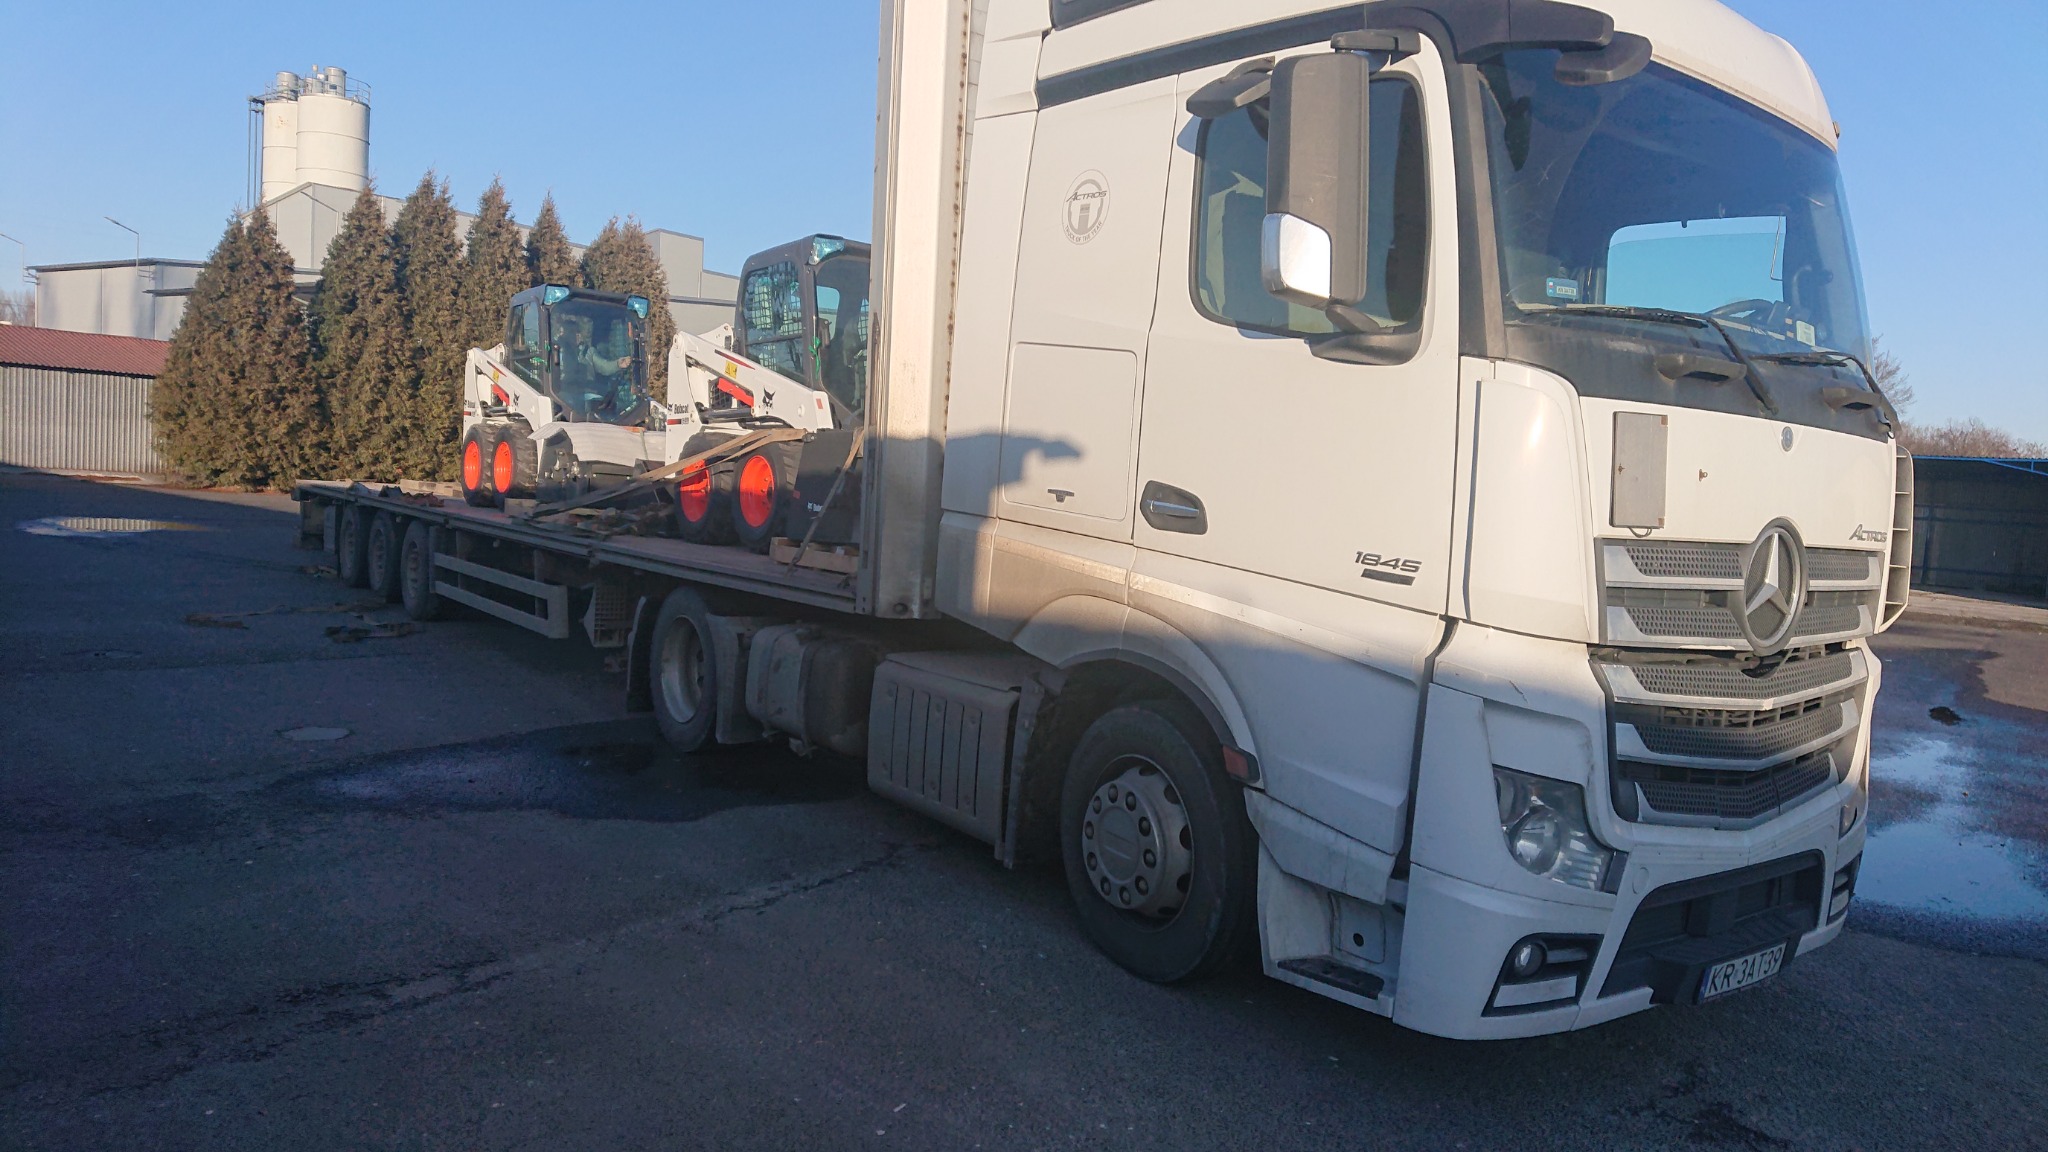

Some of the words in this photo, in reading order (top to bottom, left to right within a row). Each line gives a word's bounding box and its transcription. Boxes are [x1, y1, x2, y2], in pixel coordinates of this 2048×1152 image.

[1066, 191, 1107, 202] ACTROS
[1849, 524, 1887, 542] ACTROS
[1355, 551, 1422, 573] 1845
[1708, 963, 1735, 993] KR
[1737, 947, 1783, 984] 3AT39
